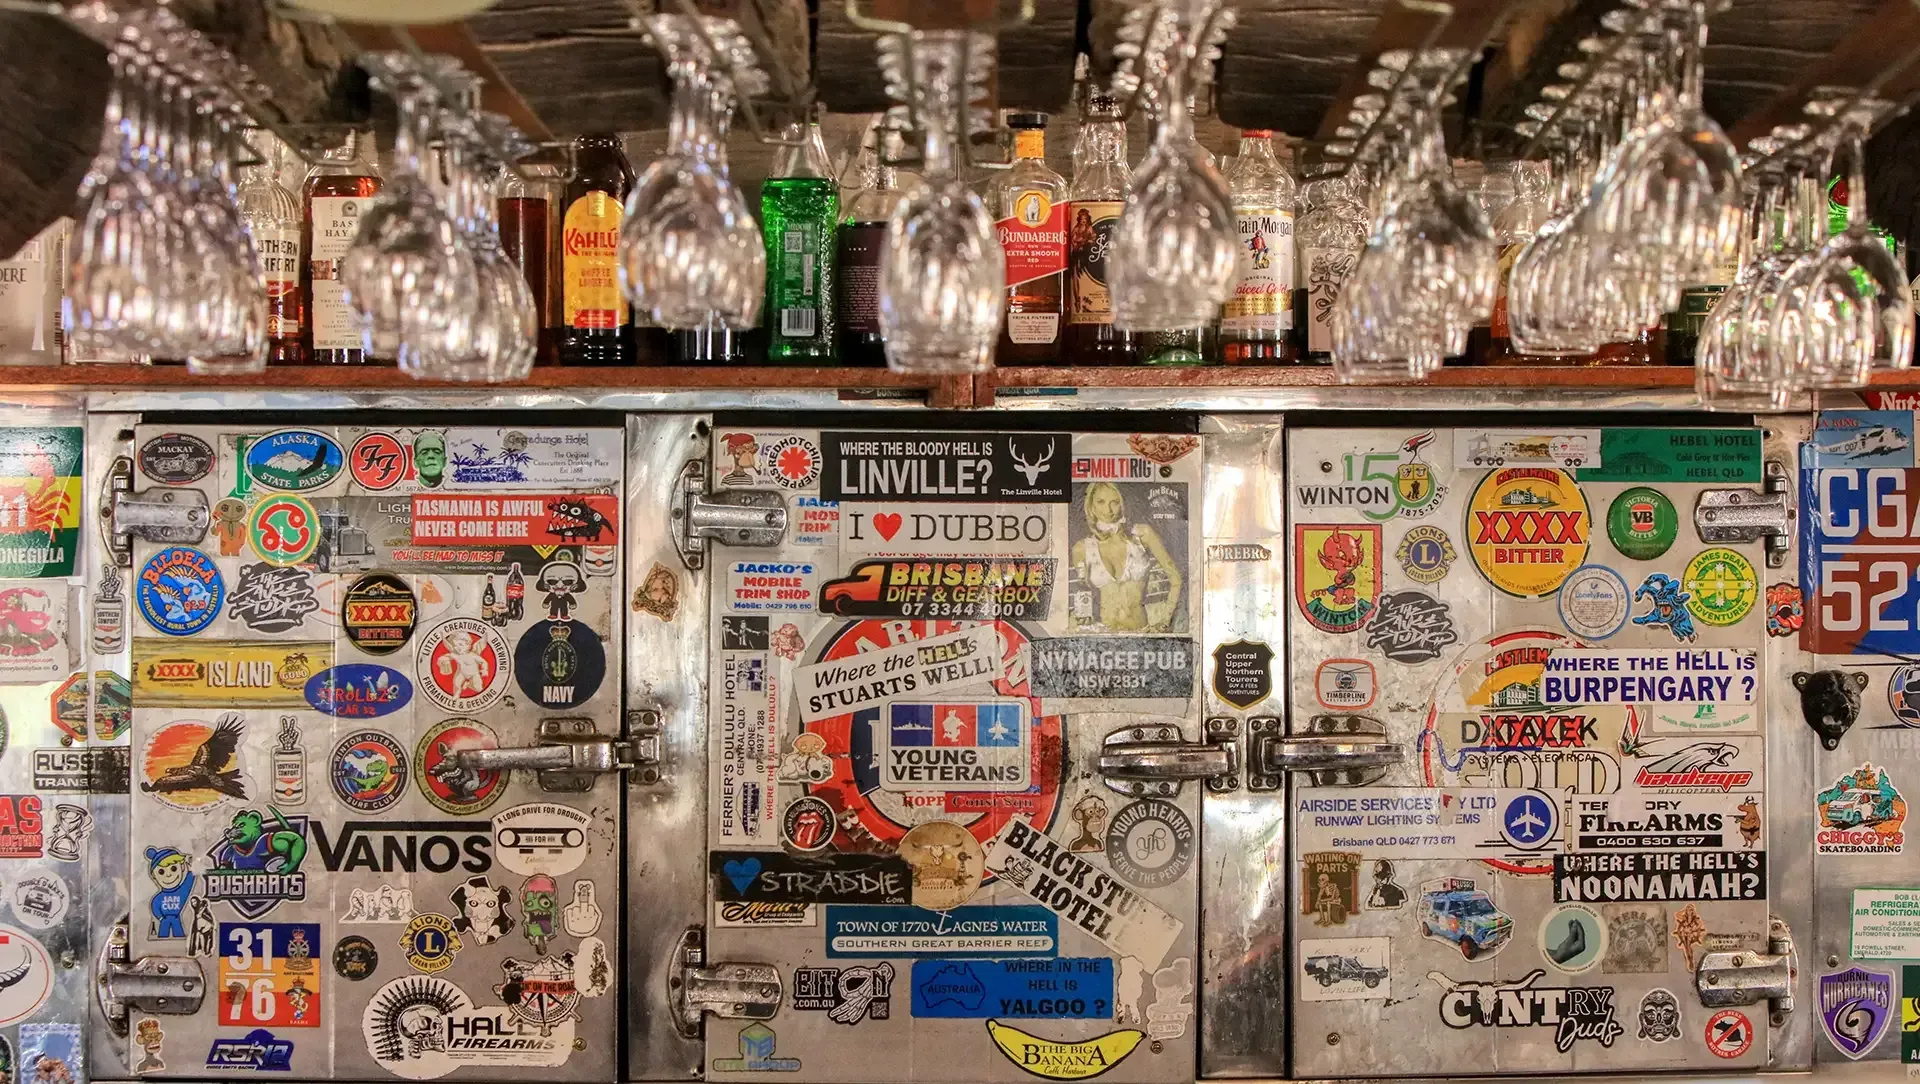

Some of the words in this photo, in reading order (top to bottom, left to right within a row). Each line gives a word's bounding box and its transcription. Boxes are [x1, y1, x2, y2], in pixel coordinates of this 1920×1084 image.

[1261, 217, 1292, 237] Morgan
[565, 228, 618, 256] KAHLÚ
[999, 227, 1068, 246] BUNDABERG
[273, 434, 319, 448] ALASKA
[840, 442, 881, 456] WHERE
[883, 442, 903, 456] THE
[905, 442, 950, 456] BLOODY
[953, 442, 980, 456] HELL
[982, 442, 993, 456] IS
[1670, 436, 1709, 447] HEBEL
[1714, 435, 1756, 447] HOTEL
[157, 446, 194, 454] MACKAY
[841, 459, 994, 494] LINVILLE?
[1091, 458, 1152, 479] MULTIRIG
[1686, 468, 1717, 477] HEBEL
[1722, 468, 1744, 478] QLD
[261, 472, 292, 488] STATE
[299, 468, 330, 487] PARKS
[1015, 488, 1041, 496] Linville
[1043, 488, 1062, 496] Hotel
[1299, 487, 1389, 506] WINTON
[415, 500, 484, 517] TASMANIA
[486, 500, 499, 516] IS
[502, 500, 545, 516] AWFUL
[1632, 511, 1653, 524] VB
[415, 521, 457, 537] NEVER
[459, 521, 494, 537] COME
[496, 521, 529, 537] HERE
[849, 513, 864, 540] I
[910, 513, 1048, 542] DUBBO
[1409, 527, 1444, 541] LIONS
[1475, 511, 1583, 545] XXXX
[391, 551, 416, 562] YOU'LL
[421, 551, 434, 561] BE
[436, 551, 455, 561] MAD
[457, 551, 468, 561] TO
[469, 551, 493, 561] MISS
[493, 551, 505, 561] IT
[1495, 548, 1564, 564] BITTER
[1693, 552, 1721, 571] JAMES
[1723, 552, 1747, 571] DEAN
[143, 551, 216, 584] BILOELA
[734, 563, 813, 574] JACKO'S
[889, 562, 1044, 586] BRISBANE
[744, 577, 803, 587] MOBILE
[735, 589, 771, 599] TRIM
[776, 589, 811, 600] SHOP
[887, 586, 927, 602] DIFF
[932, 586, 948, 602] &
[953, 586, 1041, 603] GEARBOX
[353, 606, 409, 621] XXXX
[902, 603, 920, 615] 07
[929, 603, 974, 615] 3344
[980, 603, 1025, 616] 4000
[1312, 603, 1368, 625] WINTON
[1690, 599, 1749, 621] ADVENTURES
[358, 628, 403, 639] BITTER
[422, 632, 440, 657] LITTLE
[444, 621, 487, 634] CREATURES
[491, 636, 508, 671] BREWING
[1038, 651, 1138, 671] NYMAGEE
[1143, 651, 1187, 670] PUB
[1226, 660, 1252, 669] Upper
[1545, 656, 1620, 672] WHERE
[1627, 657, 1669, 671] THE
[1675, 651, 1729, 670] HELL
[1736, 656, 1756, 671] IS
[156, 664, 196, 677] XXXX
[206, 659, 275, 689] ISLAND
[725, 654, 736, 700] HOTEL
[815, 666, 878, 689] Where
[883, 654, 915, 673] the
[809, 673, 917, 714] STUARTS
[921, 655, 995, 687] WELL!
[1078, 675, 1110, 689] NSW
[1112, 675, 1148, 688] 2831
[1545, 676, 1732, 703] BURPENGARY
[1741, 676, 1756, 702] ?
[422, 676, 458, 709] FREMANTLE
[459, 701, 465, 709] &
[466, 688, 497, 709] GEELONG
[543, 686, 575, 703] NAVY
[1326, 692, 1366, 700] TIMBERLINE
[738, 706, 746, 729] QLD.
[724, 704, 735, 756] DULULU
[335, 736, 363, 762] WINTON
[366, 735, 402, 762] OUTBACK
[737, 732, 746, 776] CENTRAL
[891, 750, 977, 764] YOUNG
[892, 766, 1020, 781] VETERANS
[1634, 768, 1753, 794] hawkeye
[346, 798, 370, 811] SURF
[373, 794, 394, 809] CLUB
[723, 764, 734, 836] FERRIER'S
[1299, 799, 1359, 813] AIRSIDE
[1361, 797, 1434, 811] SERVICES
[1471, 796, 1497, 809] LTD
[502, 808, 521, 822] LONG
[522, 806, 542, 816] DRIVE
[542, 806, 556, 814] FOR
[557, 808, 588, 825] DROUGHT
[1111, 803, 1148, 838] YOUNG
[1149, 801, 1193, 841] HENRYS
[1315, 815, 1364, 826] RUNWAY
[1367, 814, 1423, 825] LIGHTING
[1332, 837, 1375, 847] Brisbane
[1376, 837, 1397, 847] QLD
[1399, 837, 1422, 845] 0427
[1423, 836, 1439, 845] 773
[1441, 836, 1456, 845] 671
[1597, 837, 1635, 846] 0400
[1642, 837, 1671, 846] 630
[1677, 837, 1706, 846] 637
[1817, 831, 1904, 845] CHIGGY'S
[309, 821, 492, 874] VANOS
[1004, 820, 1094, 889] BLACK
[1819, 845, 1902, 853] SKATEBOARDING
[1305, 852, 1344, 865] WAITING
[1347, 854, 1361, 865] ON
[1563, 853, 1635, 872] WHERE
[1642, 854, 1681, 871] THE
[1689, 853, 1760, 871] HELL'S
[1112, 852, 1137, 880] SERVE
[1137, 873, 1158, 884] THE
[1159, 851, 1190, 881] PEOPLE
[1316, 862, 1349, 873] PARTS
[208, 875, 304, 897] BUSHRATS
[760, 870, 905, 895] STRADDIE
[1560, 872, 1760, 900] NOONAMAH?
[33, 909, 50, 919] TOUR
[1030, 872, 1114, 942] HOTEL
[413, 915, 450, 932] LIONS
[837, 921, 879, 932] TOWN
[881, 921, 899, 932] OF
[901, 921, 930, 932] 1770
[952, 921, 998, 932] AGNES
[1001, 920, 1048, 932] WATER
[228, 927, 273, 971] 31
[837, 940, 906, 948] SOUTHERN
[912, 939, 954, 948] GREAT
[957, 939, 1012, 948] BARRIER
[1017, 938, 1049, 948] REEF
[1004, 962, 1051, 973] WHERE
[1058, 962, 1073, 973] IN
[1077, 962, 1101, 973] THE
[1028, 980, 1059, 991] HELL
[1064, 980, 1078, 991] IS
[1837, 972, 1870, 982] BURNIE
[927, 983, 981, 994] AUSTRALIA
[1823, 981, 1889, 1013] HURRICANES
[226, 979, 277, 1021] 76
[1000, 998, 1085, 1015] YALGOO
[1095, 998, 1107, 1015] ?
[451, 1038, 556, 1051] FIREARMS
[1040, 1045, 1069, 1053] THE
[1070, 1045, 1092, 1054] BIG
[1022, 1045, 1108, 1066] BANANA
